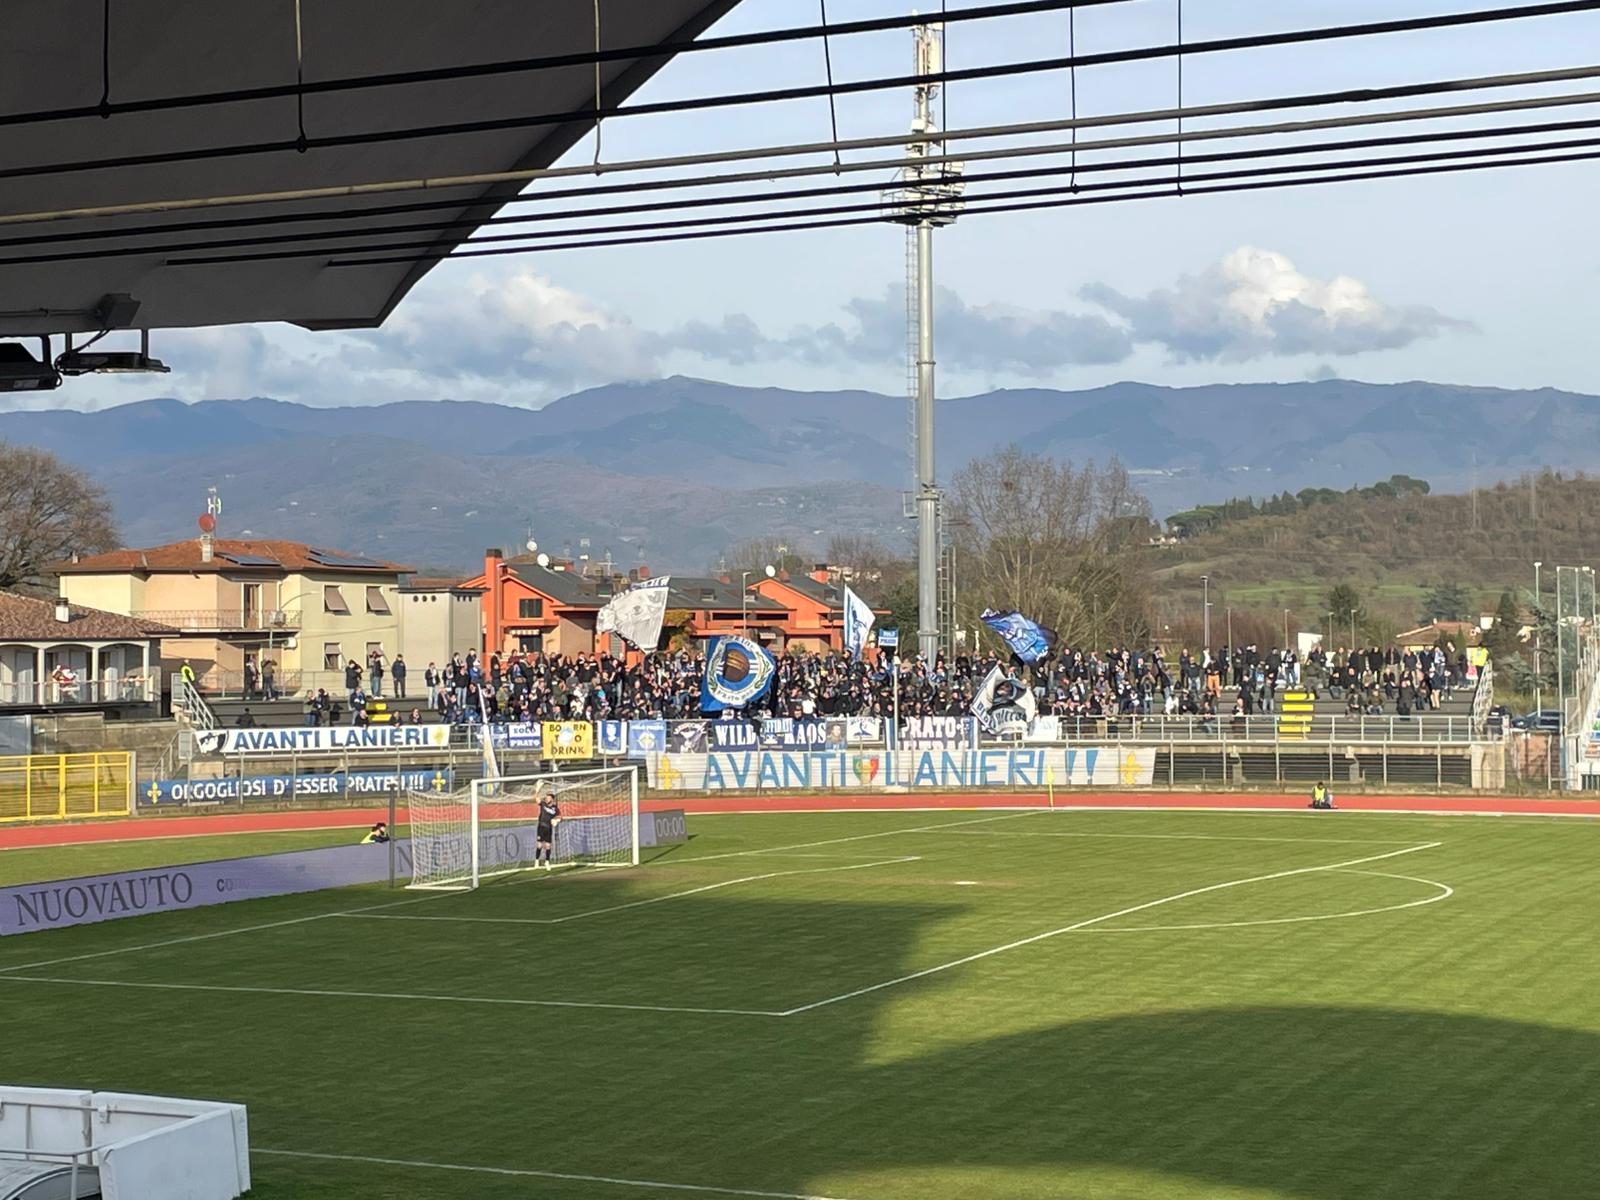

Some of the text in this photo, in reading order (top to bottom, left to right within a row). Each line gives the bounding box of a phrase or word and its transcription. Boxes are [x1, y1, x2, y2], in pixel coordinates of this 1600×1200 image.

[234, 727, 429, 750] AVANTI LANIERI
[510, 739, 541, 747] PRATO
[714, 723, 758, 746] WILD
[551, 747, 585, 756] DRINK
[702, 751, 845, 789] AVANTI
[885, 750, 1045, 787] LANIERI
[171, 778, 267, 800] ORGOGLIOSI
[294, 777, 339, 794] ESSER
[656, 818, 686, 837] 00:00
[14, 871, 193, 926] NUOVAUTO
